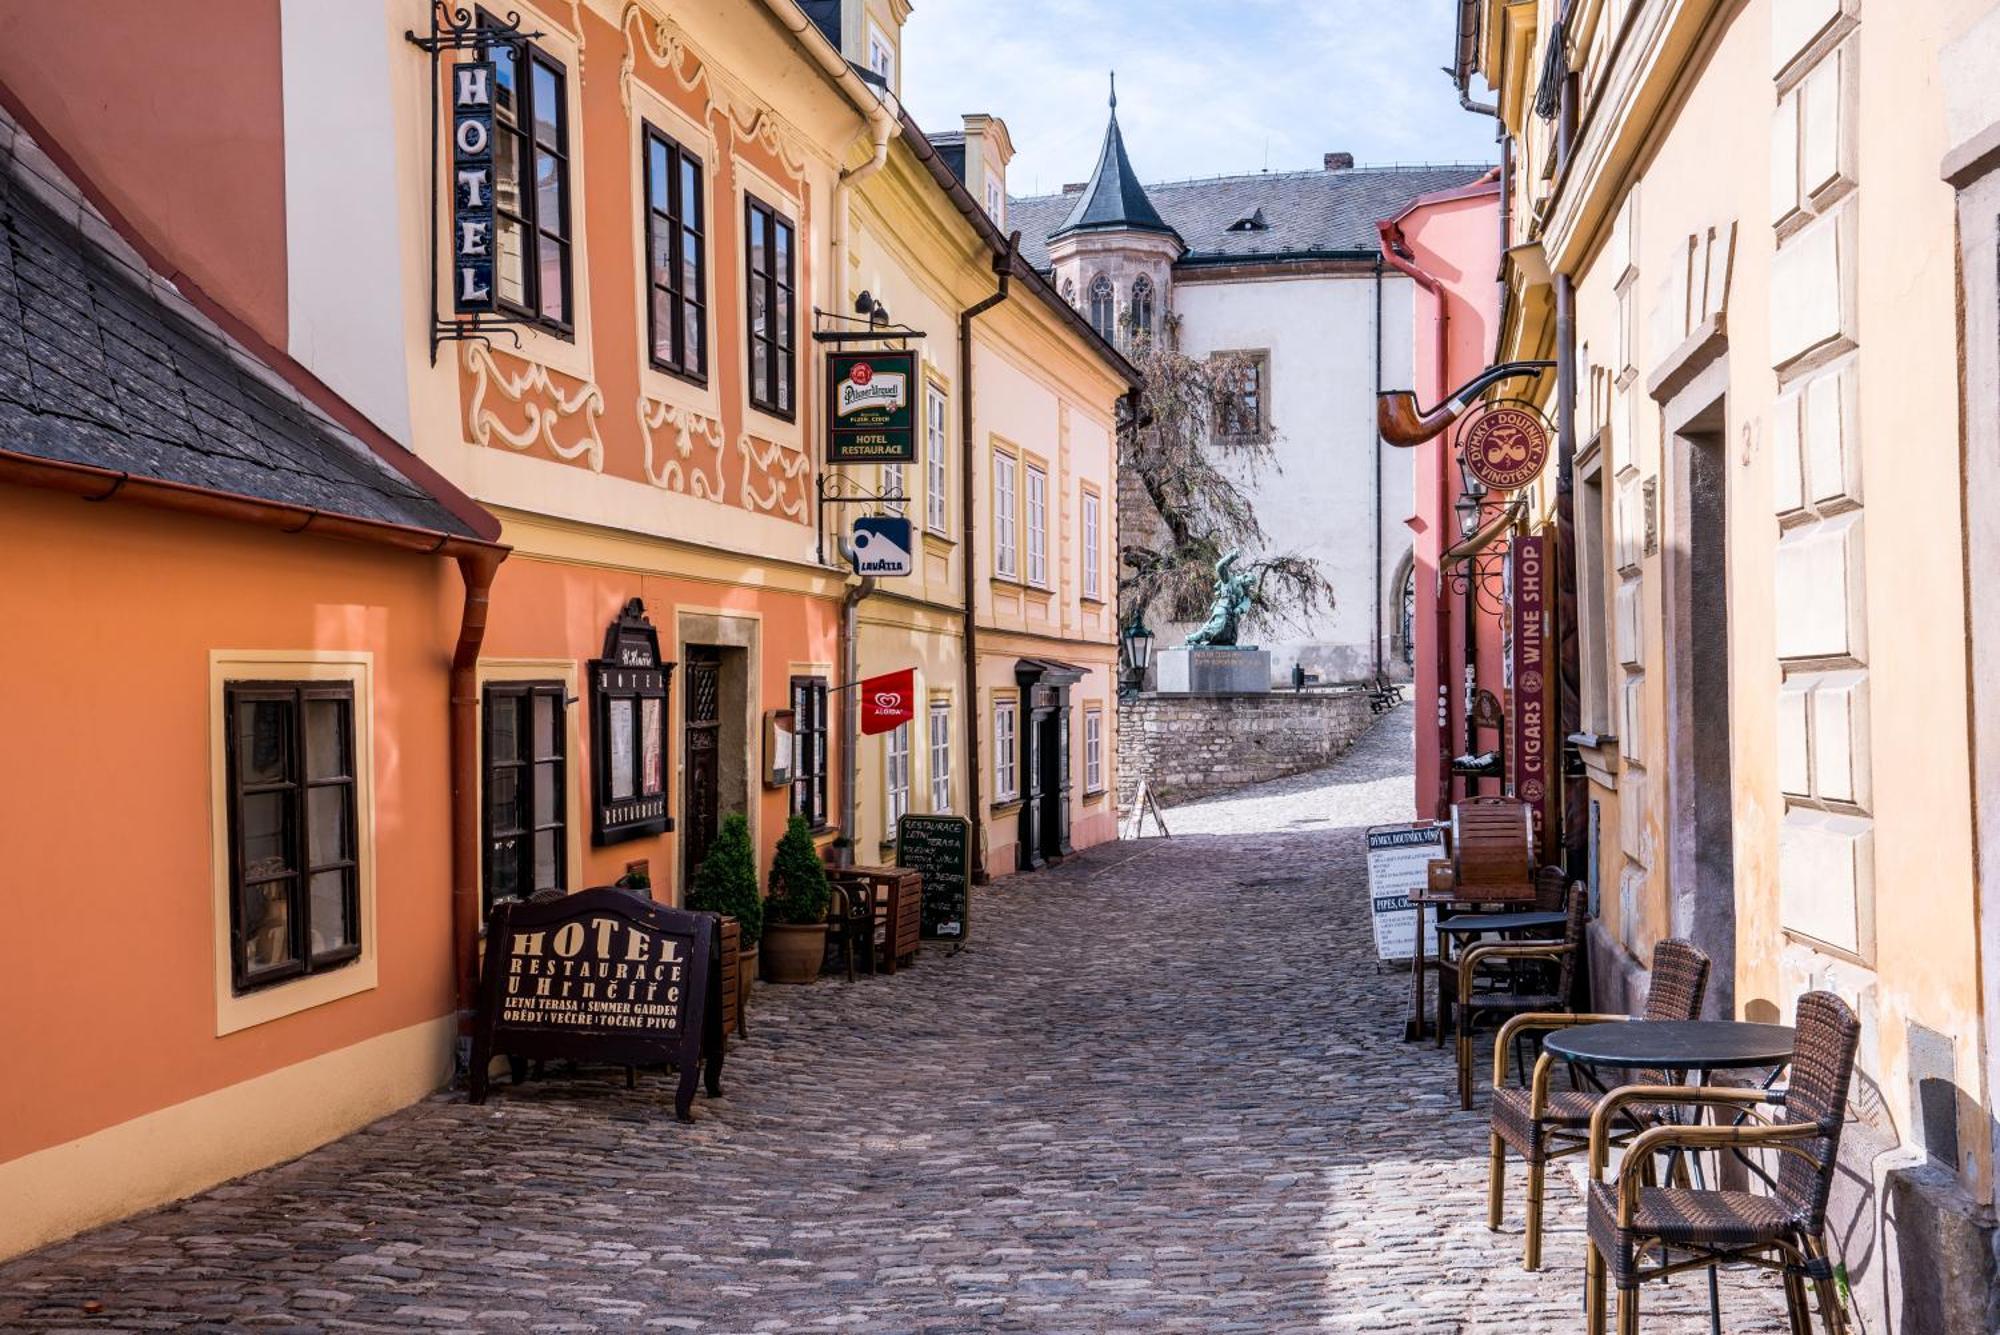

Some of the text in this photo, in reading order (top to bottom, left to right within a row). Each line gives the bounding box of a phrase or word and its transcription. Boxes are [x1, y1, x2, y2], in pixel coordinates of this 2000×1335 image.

[457, 68, 489, 301] HOTEL
[842, 446, 902, 455] RESTAURACE
[856, 435, 888, 444] HOTEL
[861, 559, 903, 571] LAVAZZA
[1523, 546, 1541, 665] WINE SHOP
[603, 673, 663, 688] HOTEL
[1524, 701, 1541, 772] CIGARS
[605, 801, 662, 825] RESTAURACE
[512, 918, 684, 963] HOTEL
[510, 958, 681, 981] RESTAURACE
[508, 976, 679, 1003] U Hrnčíře
[505, 996, 678, 1016] LETNÍ TERASA SUMMER GARDEN
[646, 1016, 677, 1029] PIVO
